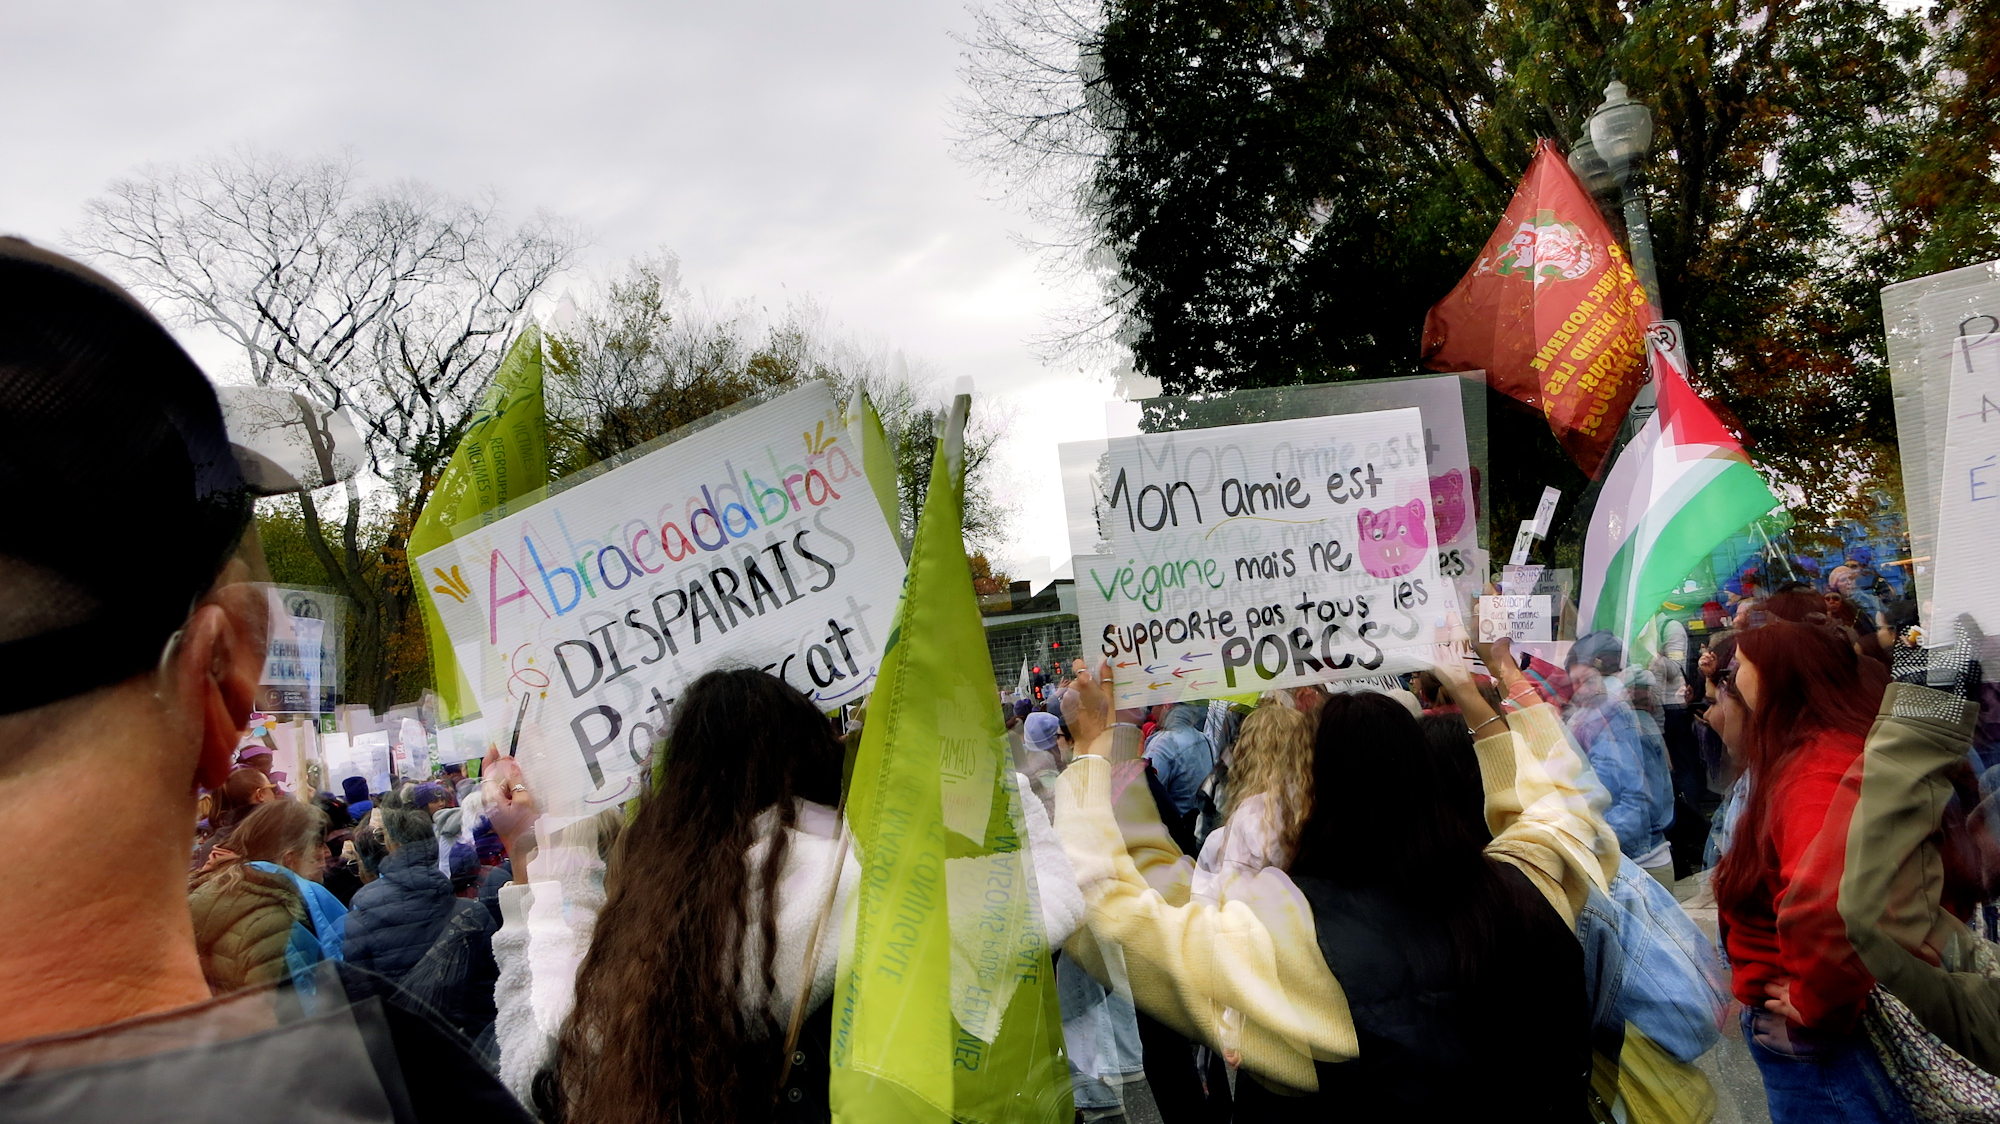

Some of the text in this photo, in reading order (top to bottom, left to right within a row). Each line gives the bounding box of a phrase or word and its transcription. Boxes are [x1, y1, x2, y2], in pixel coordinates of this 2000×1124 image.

[467, 442, 492, 493] VICTIMES
[1089, 462, 1384, 533] Mon amie est
[490, 468, 842, 646] Abracadabra
[1235, 546, 1297, 583] mais
[1308, 540, 1352, 572] ne
[552, 529, 837, 699] DISPARAIS
[1245, 602, 1286, 641] pas
[1295, 591, 1370, 623] tous
[1393, 578, 1429, 610] les
[1511, 621, 1535, 631] monde
[1517, 610, 1540, 620] femmes
[1220, 621, 1384, 689] PORCS
